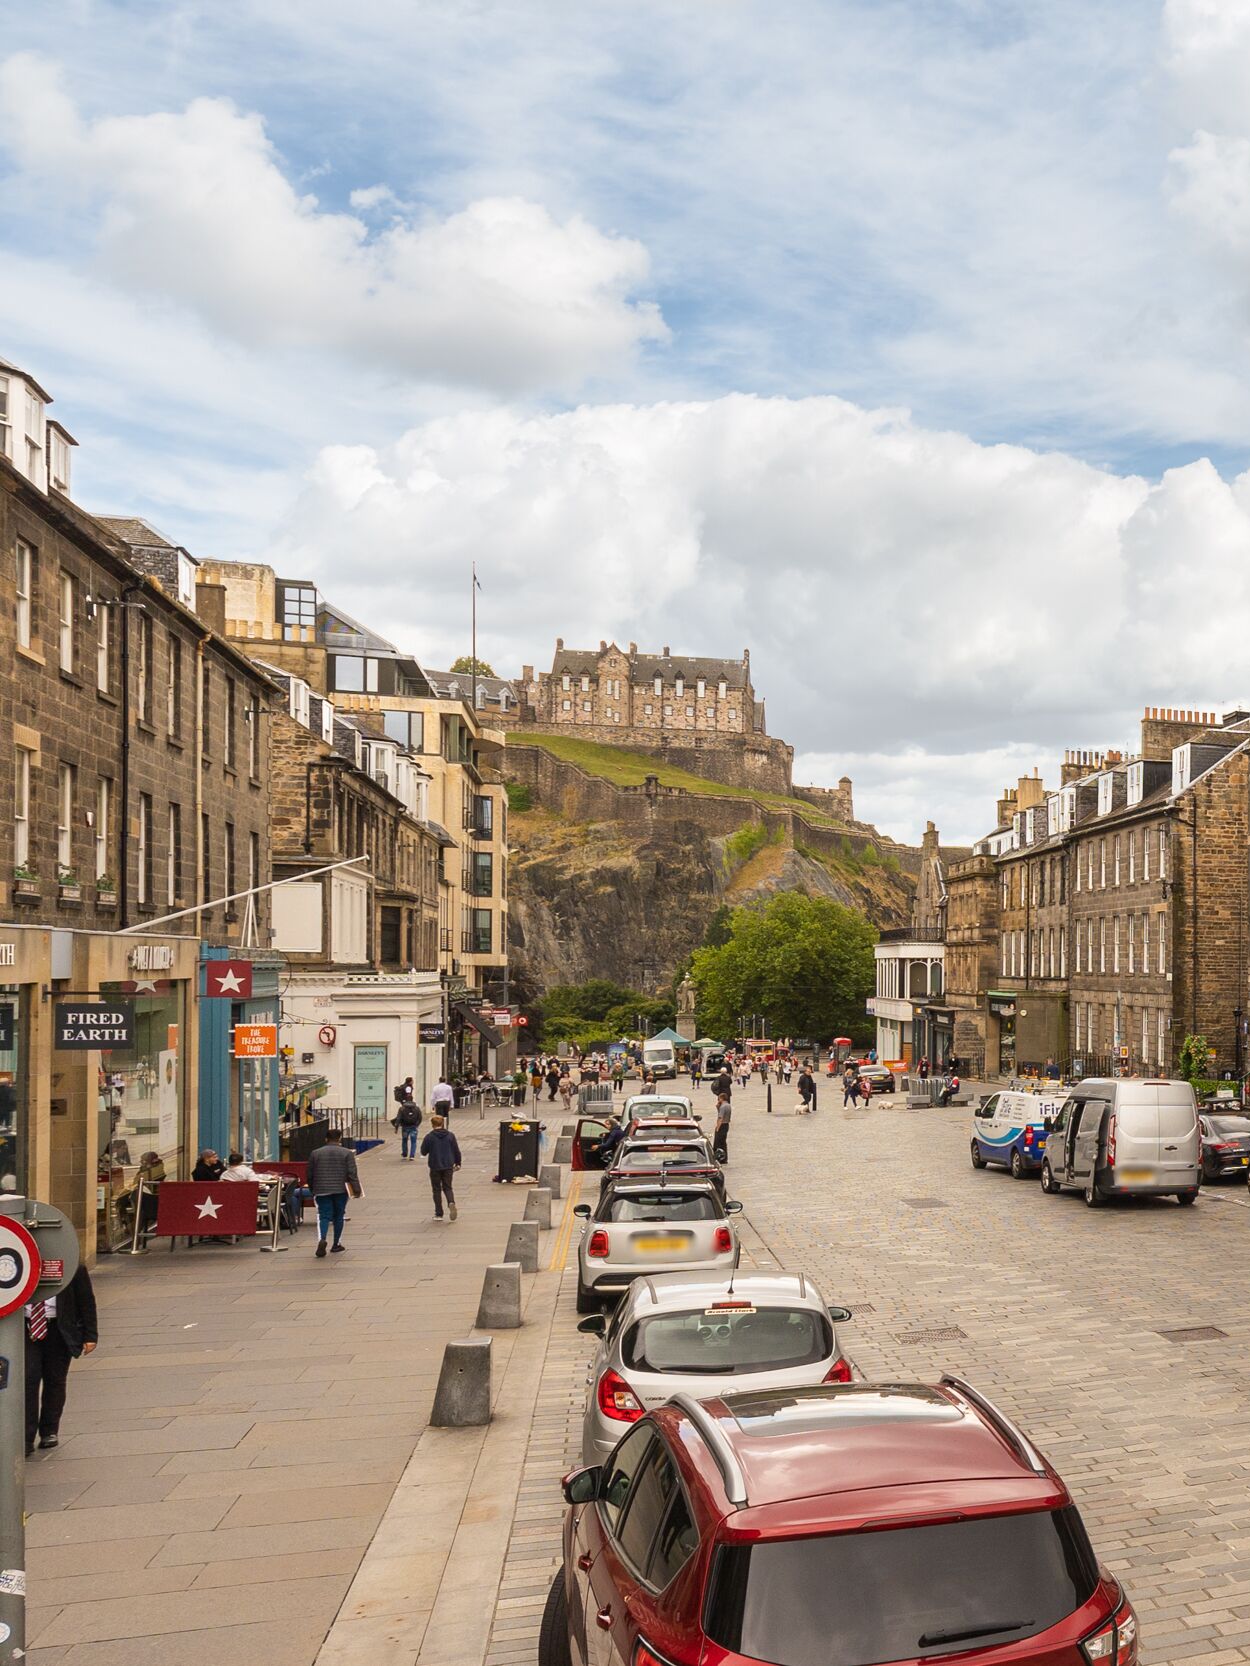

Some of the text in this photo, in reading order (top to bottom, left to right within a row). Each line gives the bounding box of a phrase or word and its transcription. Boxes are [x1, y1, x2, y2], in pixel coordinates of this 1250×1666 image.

[66, 1013, 124, 1025] FIRED
[62, 1029, 127, 1041] EARTH
[250, 1029, 261, 1037] THE
[241, 1037, 270, 1045] TREASURE
[246, 1045, 265, 1053] TROVE
